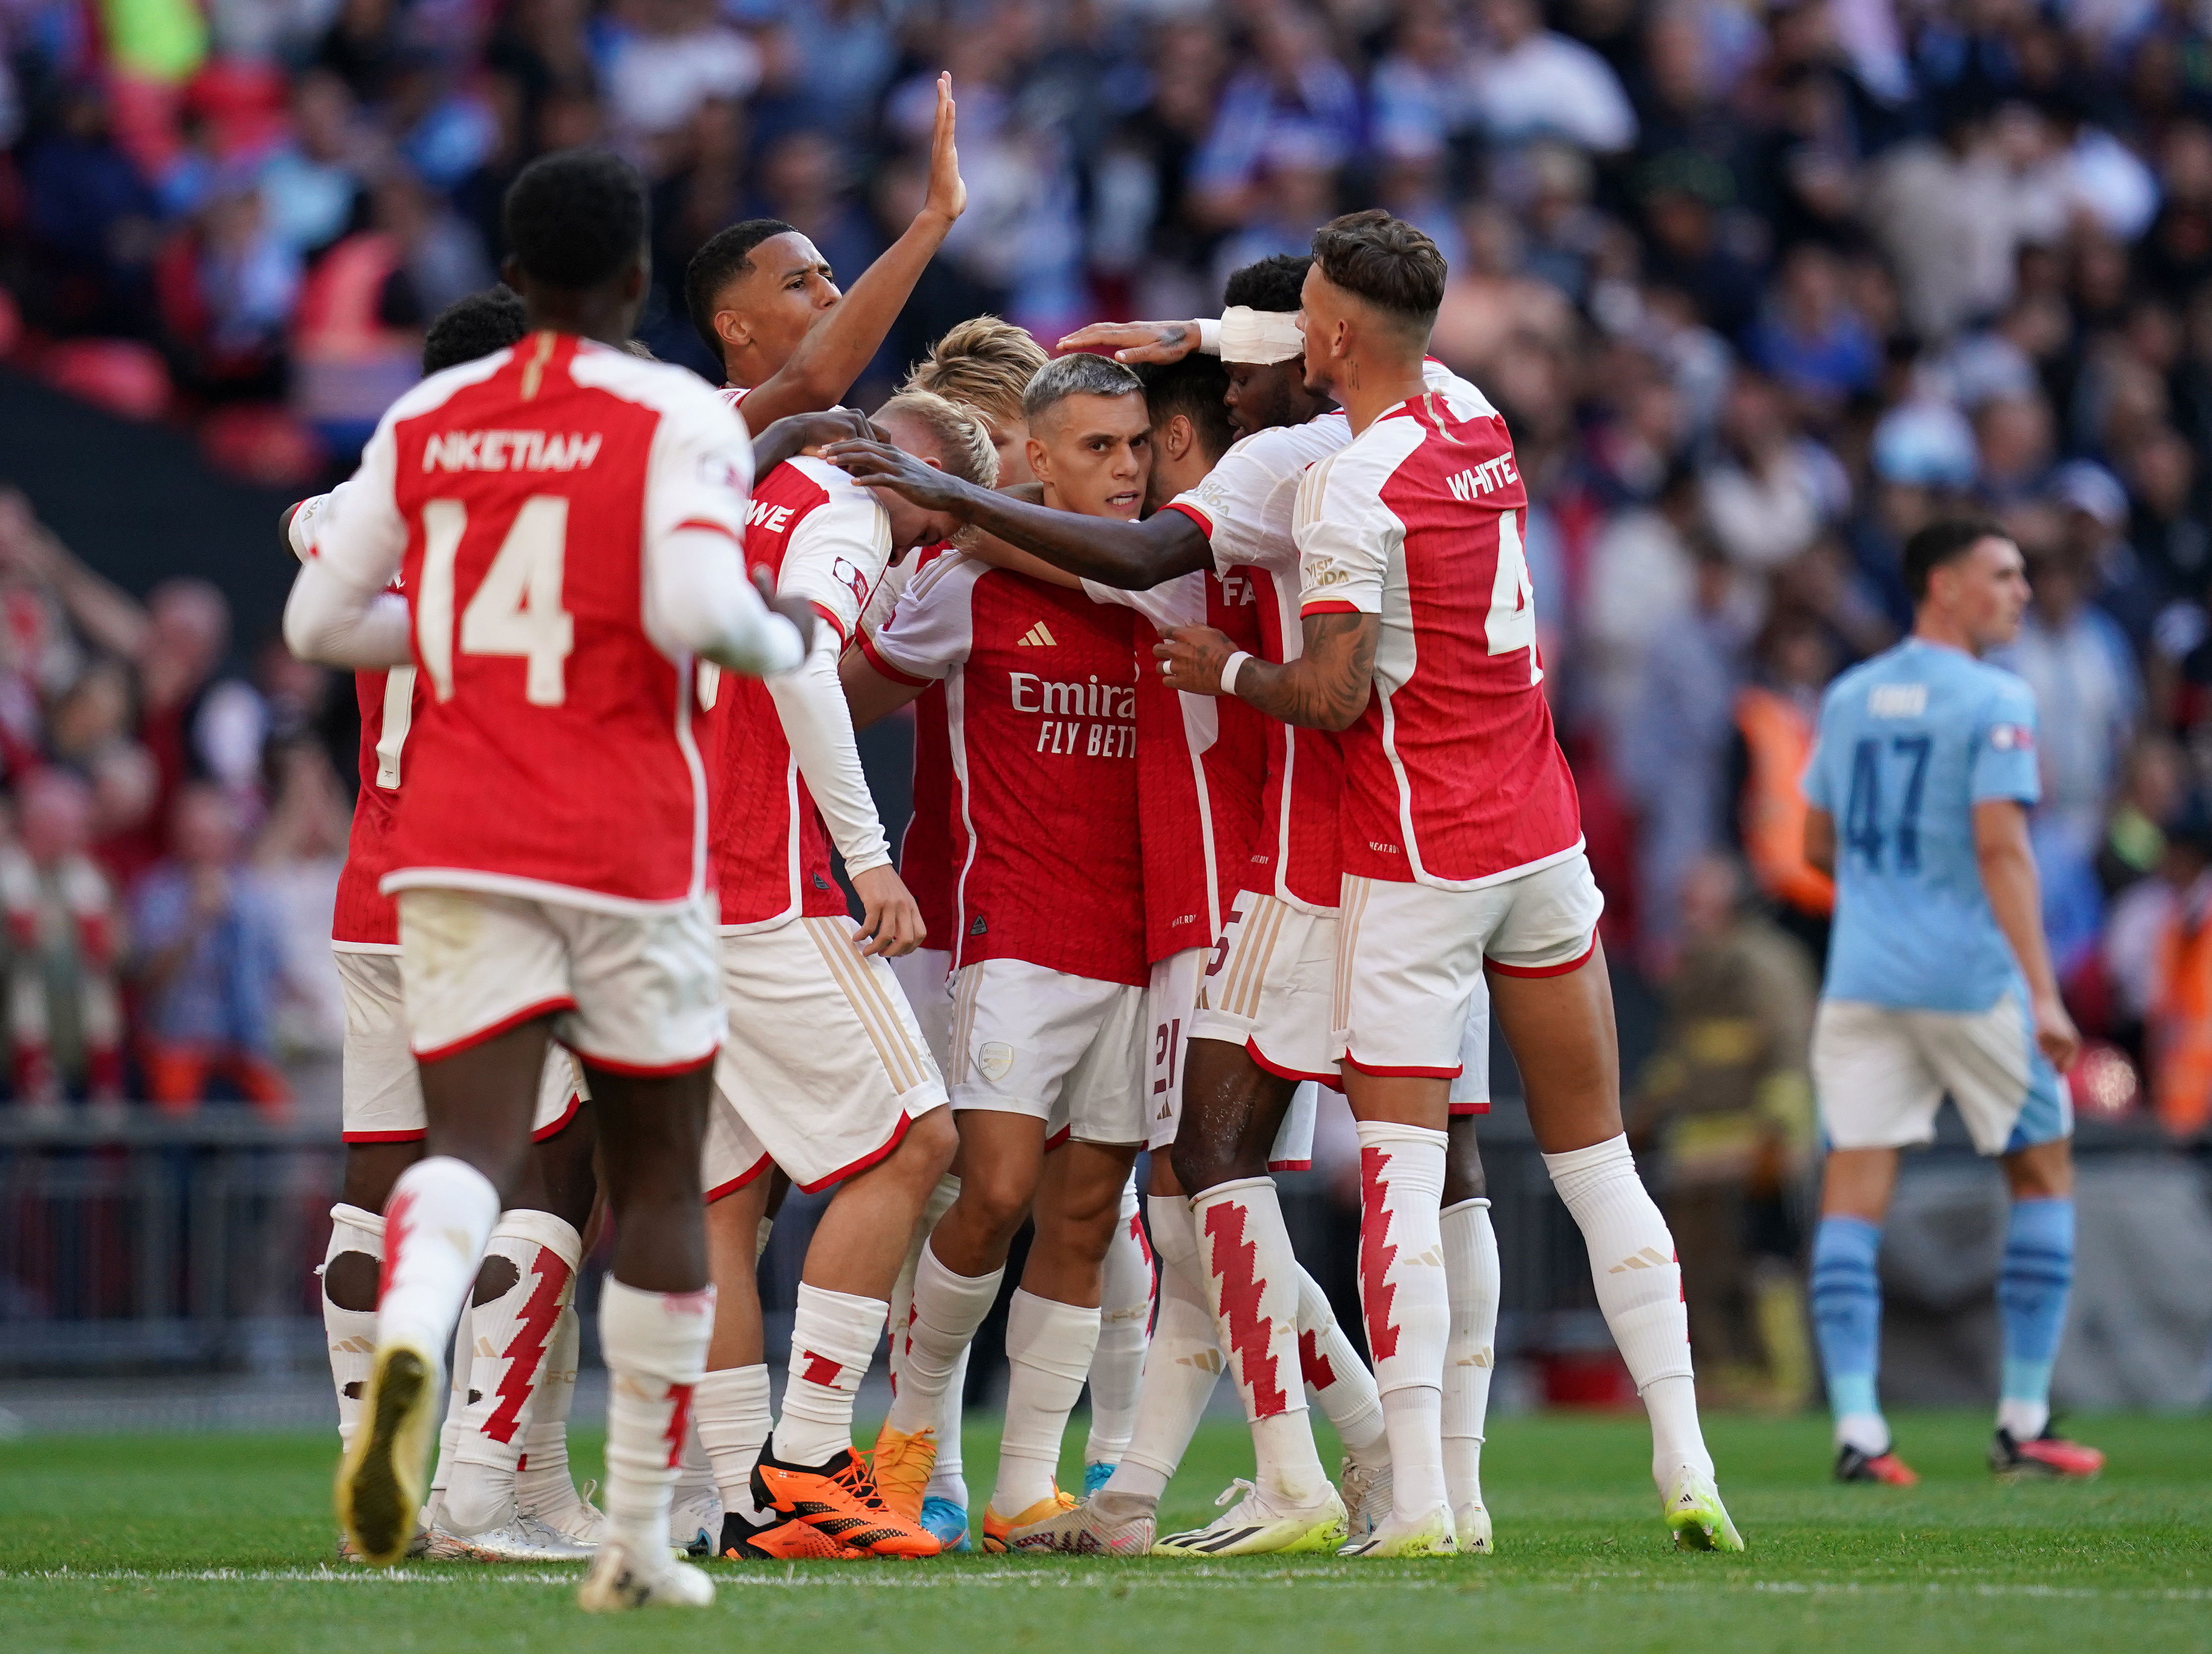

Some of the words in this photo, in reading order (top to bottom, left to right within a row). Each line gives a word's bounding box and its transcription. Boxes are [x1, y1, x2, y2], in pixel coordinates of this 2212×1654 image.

[421, 430, 603, 473] NKETIAH
[1446, 452, 1518, 501] WHITE
[416, 492, 574, 706] 14
[1484, 510, 1543, 686] 4
[1037, 721, 1080, 754] FLY
[1847, 734, 1931, 875] 47
